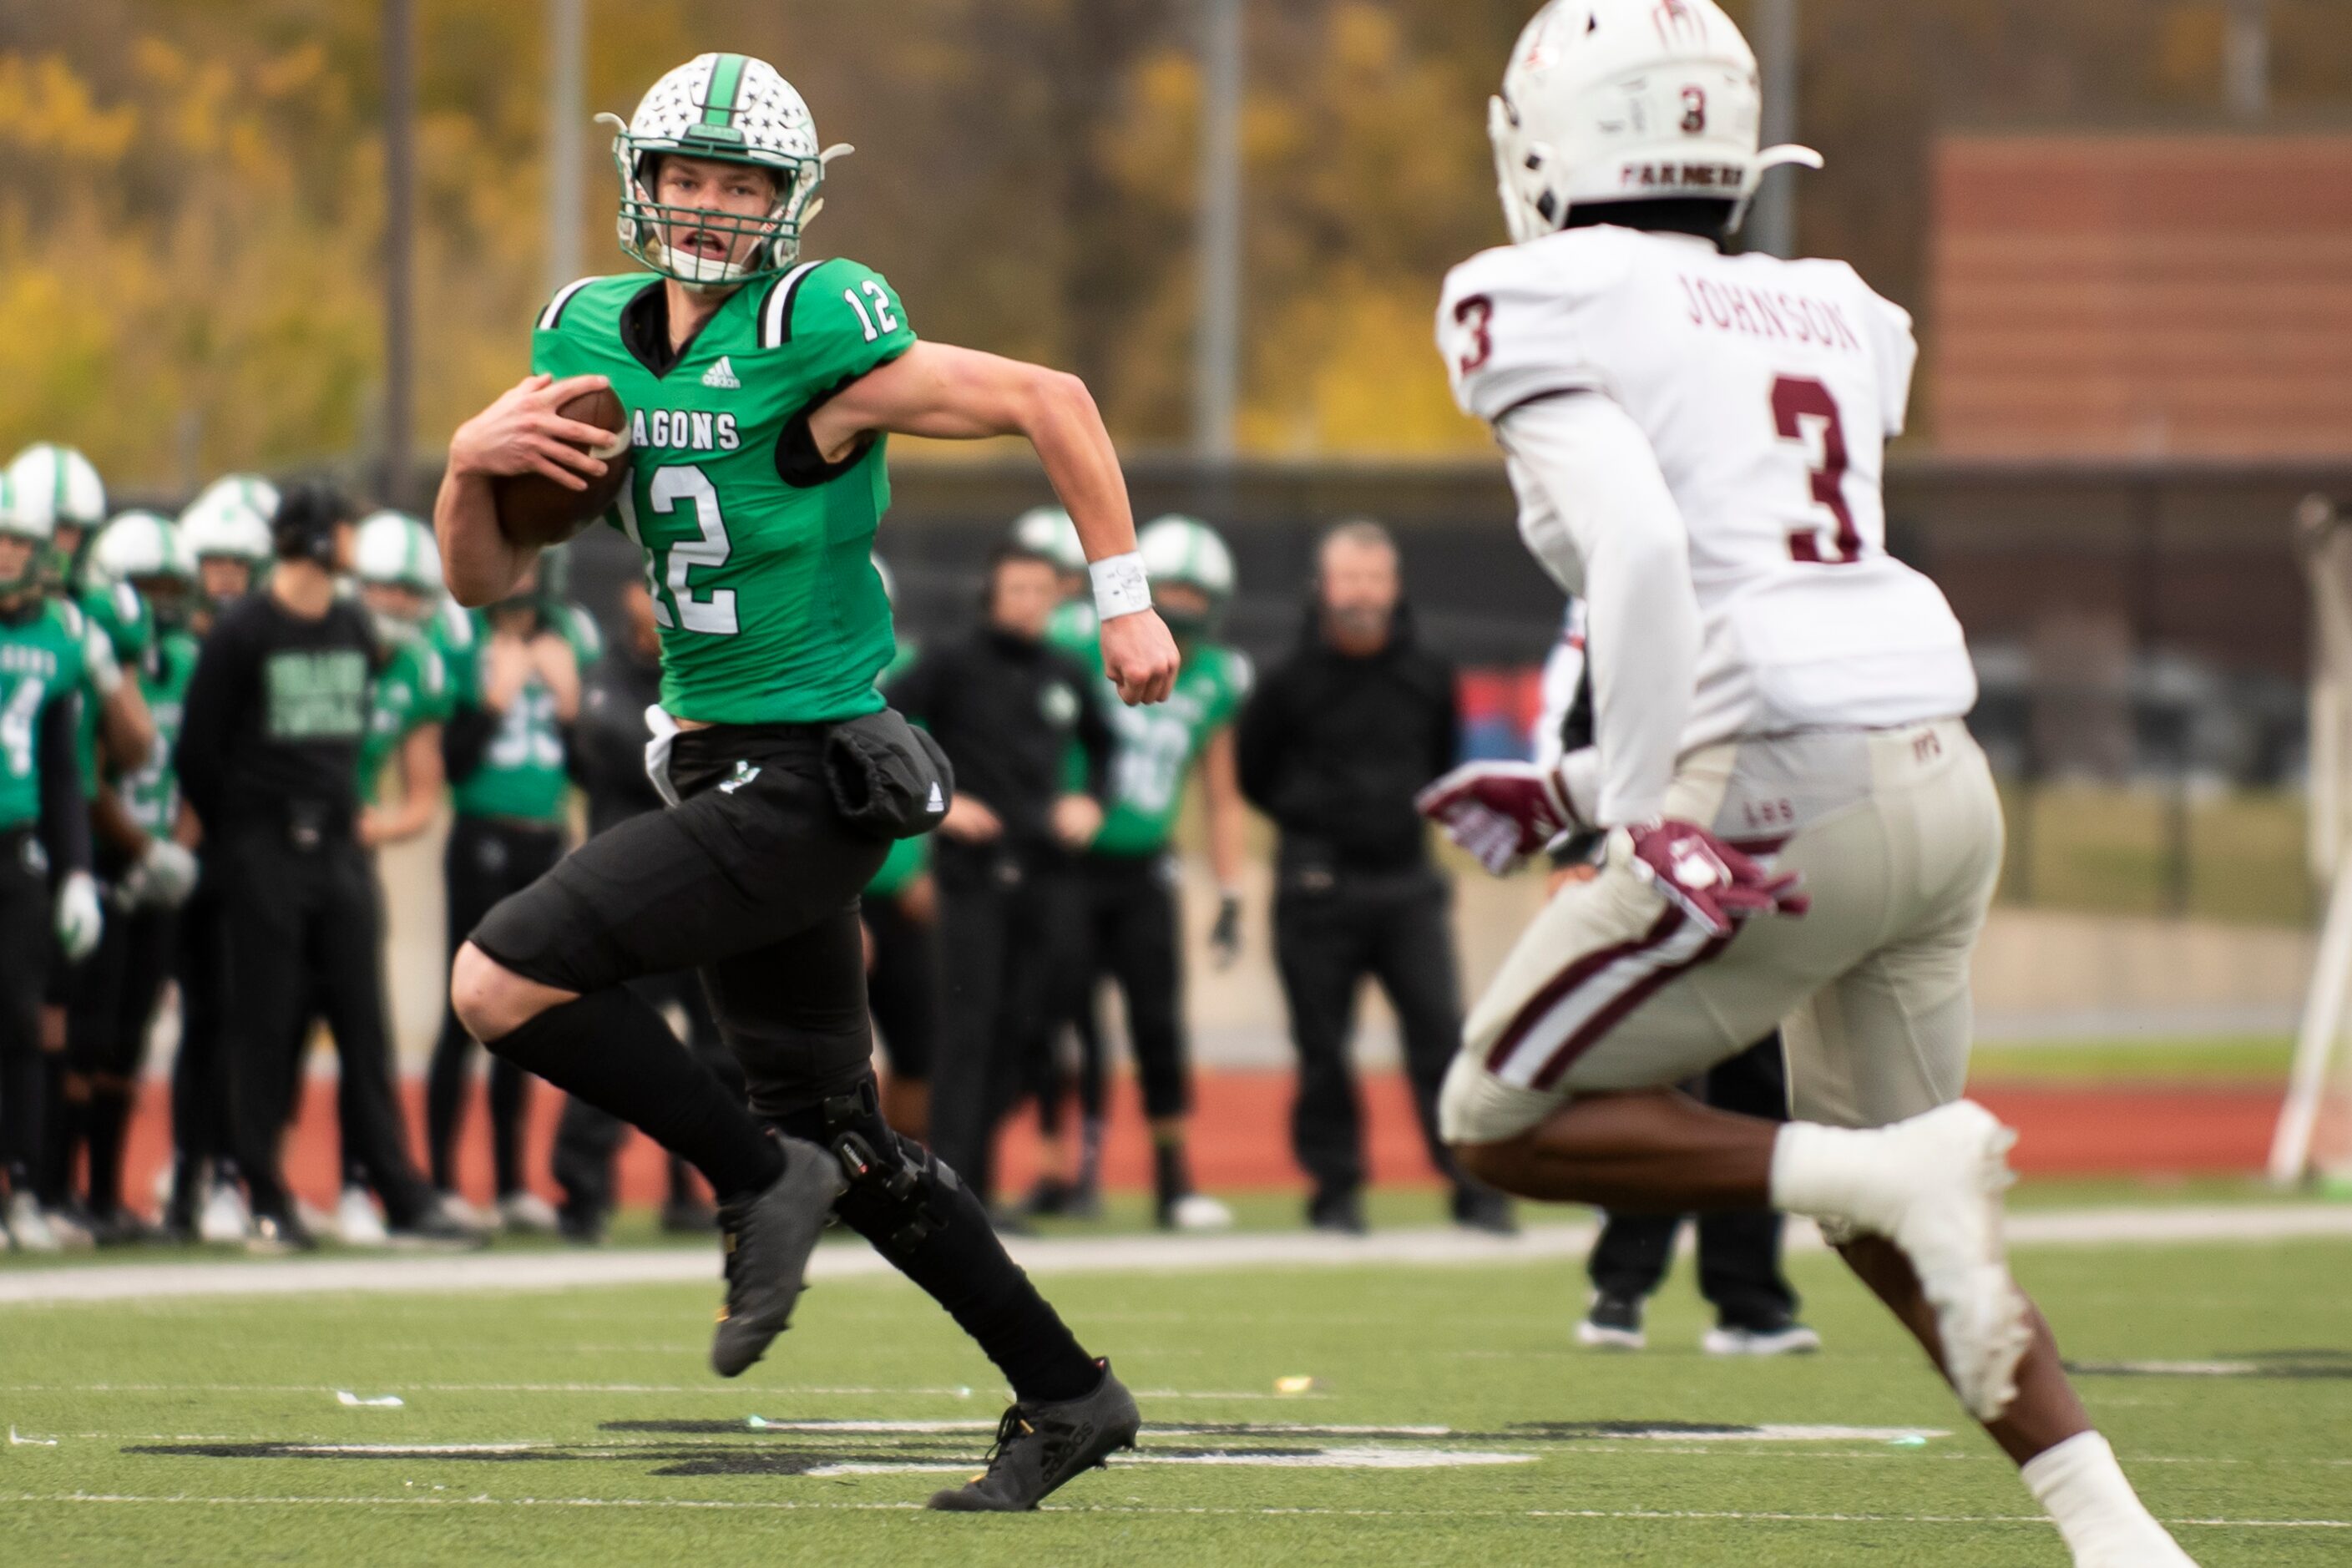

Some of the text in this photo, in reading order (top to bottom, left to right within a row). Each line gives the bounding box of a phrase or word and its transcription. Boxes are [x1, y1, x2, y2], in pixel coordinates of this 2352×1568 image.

[1679, 85, 1706, 134] 3
[842, 278, 899, 343] 12
[1454, 292, 1494, 375] 3
[1677, 273, 1863, 352] JOHNSON
[701, 373, 741, 389] adidas
[631, 408, 741, 451] AGONS
[1768, 372, 1864, 563] 3
[617, 462, 741, 636] 12
[1041, 1421, 1095, 1484] adidas
